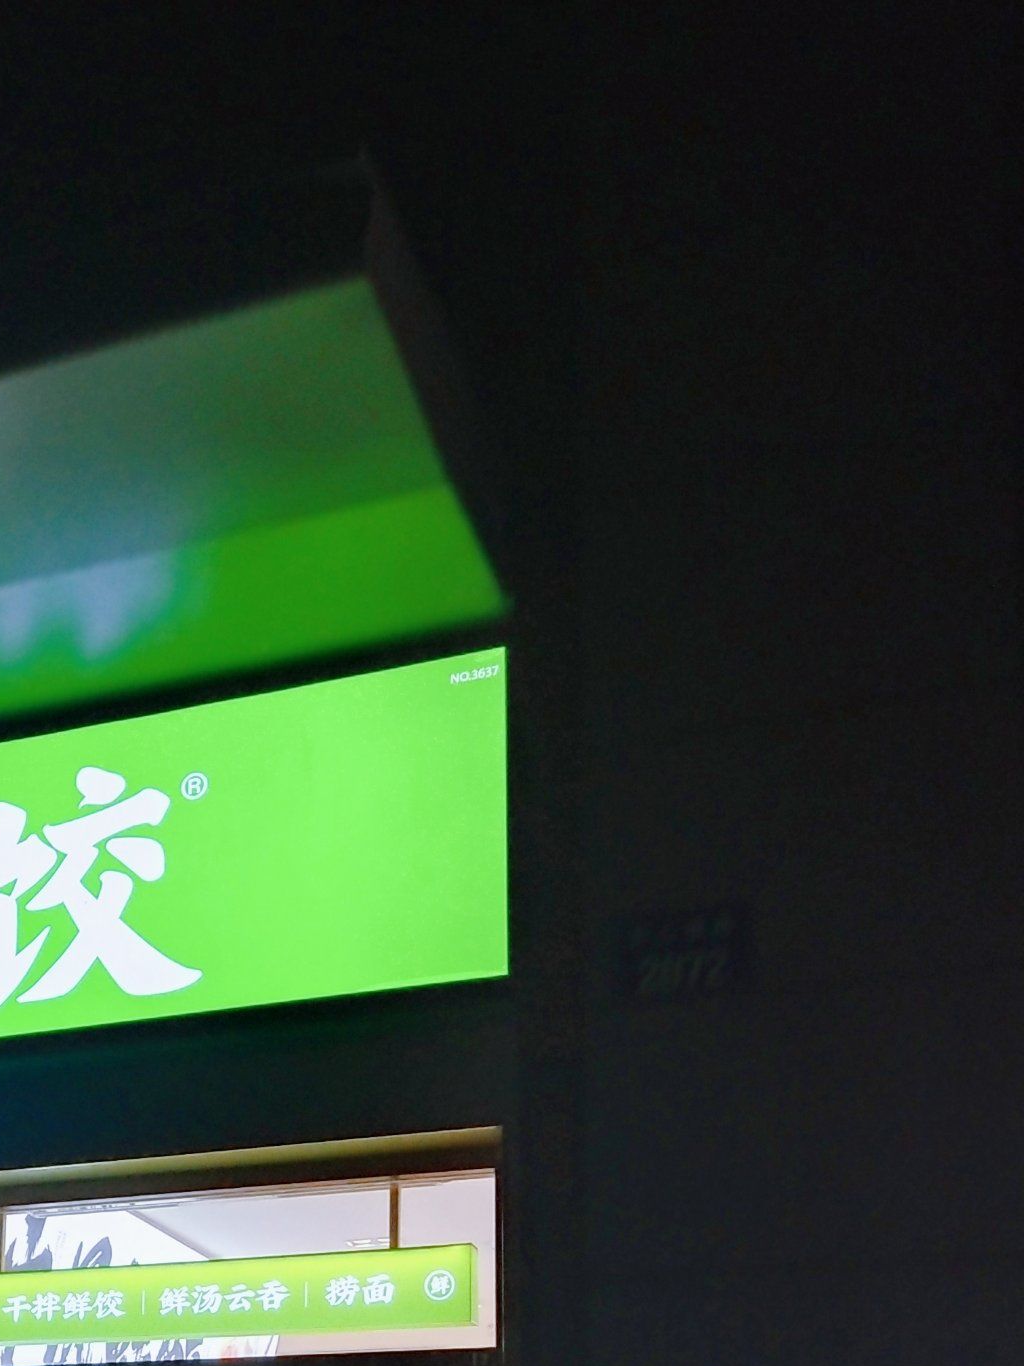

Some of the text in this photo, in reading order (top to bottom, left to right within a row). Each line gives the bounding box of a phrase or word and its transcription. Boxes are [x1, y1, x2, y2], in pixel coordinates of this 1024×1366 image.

[2, 1289, 126, 1323] 干拌鲜饺
[159, 1280, 291, 1316] 鲜汤云吞
[325, 1273, 396, 1306] 捞面
